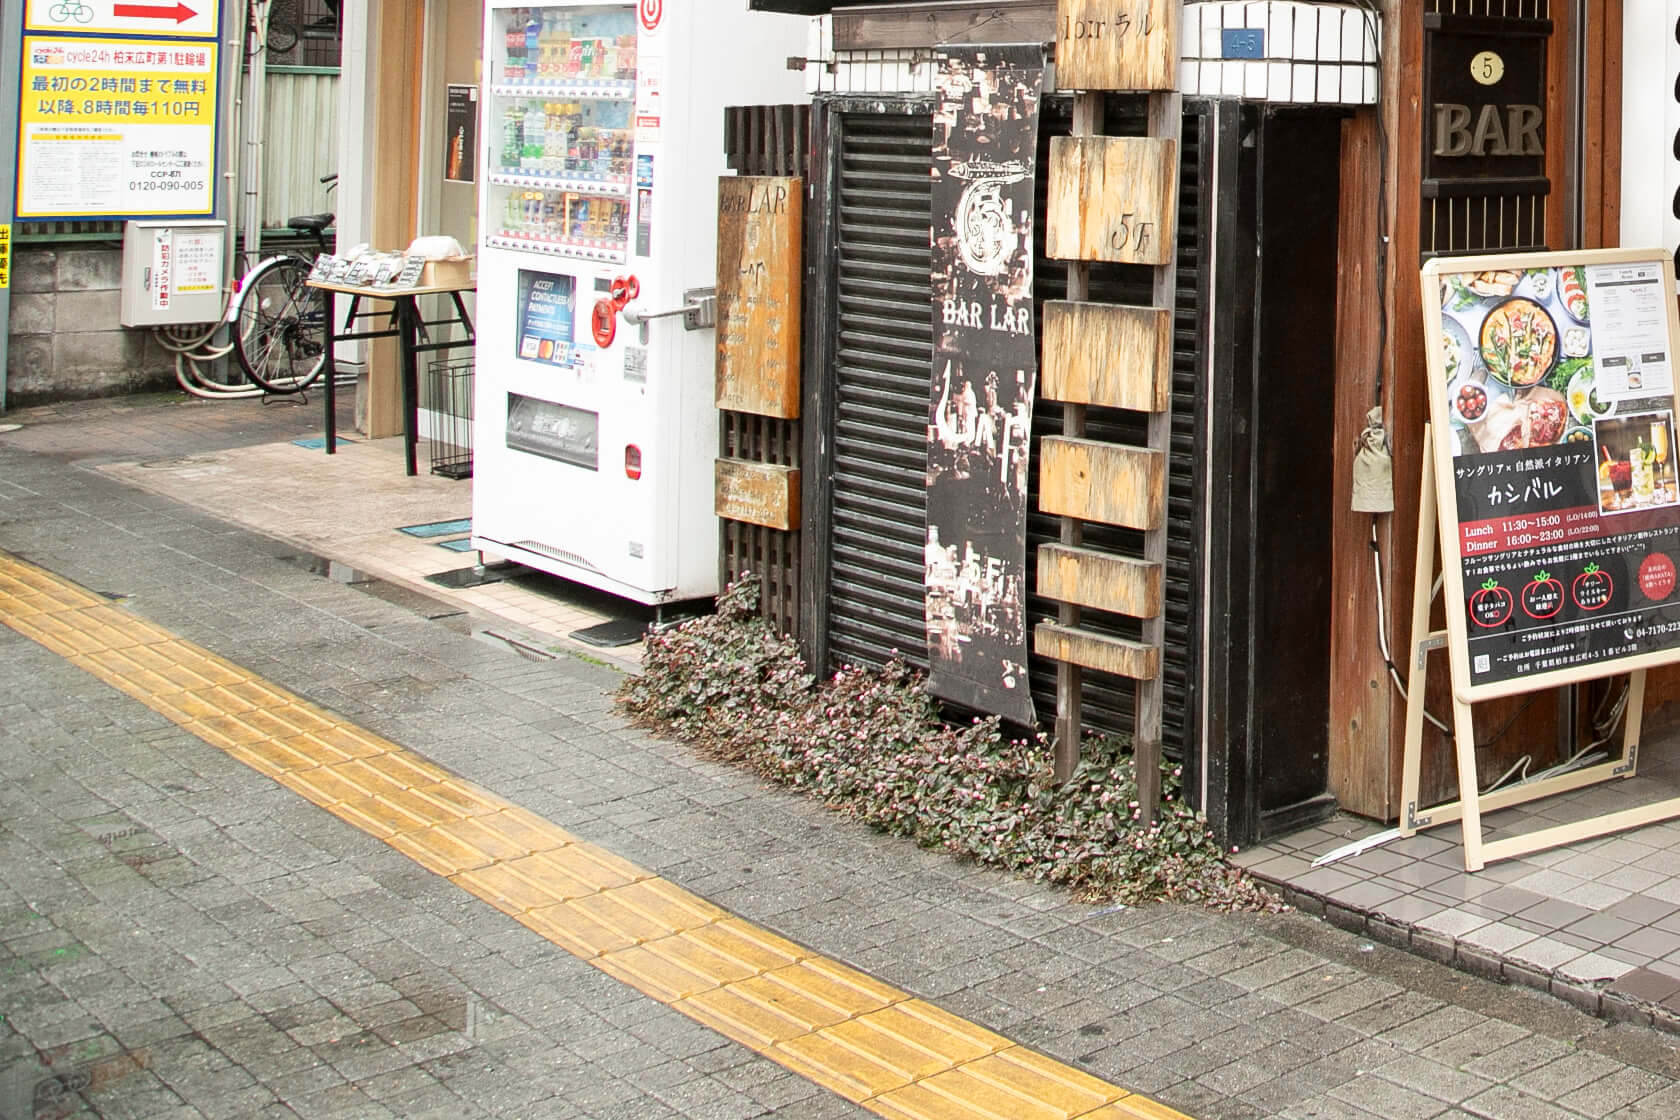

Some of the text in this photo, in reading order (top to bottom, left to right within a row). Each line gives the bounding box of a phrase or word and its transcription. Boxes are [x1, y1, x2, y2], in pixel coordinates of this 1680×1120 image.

[1231, 34, 1256, 52] 4-5
[67, 49, 110, 64] cycle24h
[1482, 57, 1493, 79] 5
[32, 76, 206, 95] 最初の2時間まで無料
[1434, 103, 1545, 157] BAR
[129, 181, 204, 191] 0120-090-005
[747, 184, 786, 214] LAR
[1112, 213, 1154, 252] 5F
[942, 299, 1030, 336] BAR LAR
[1487, 477, 1562, 505] カシバル
[1465, 524, 1493, 538] Lunch
[1466, 540, 1498, 552] Dinner
